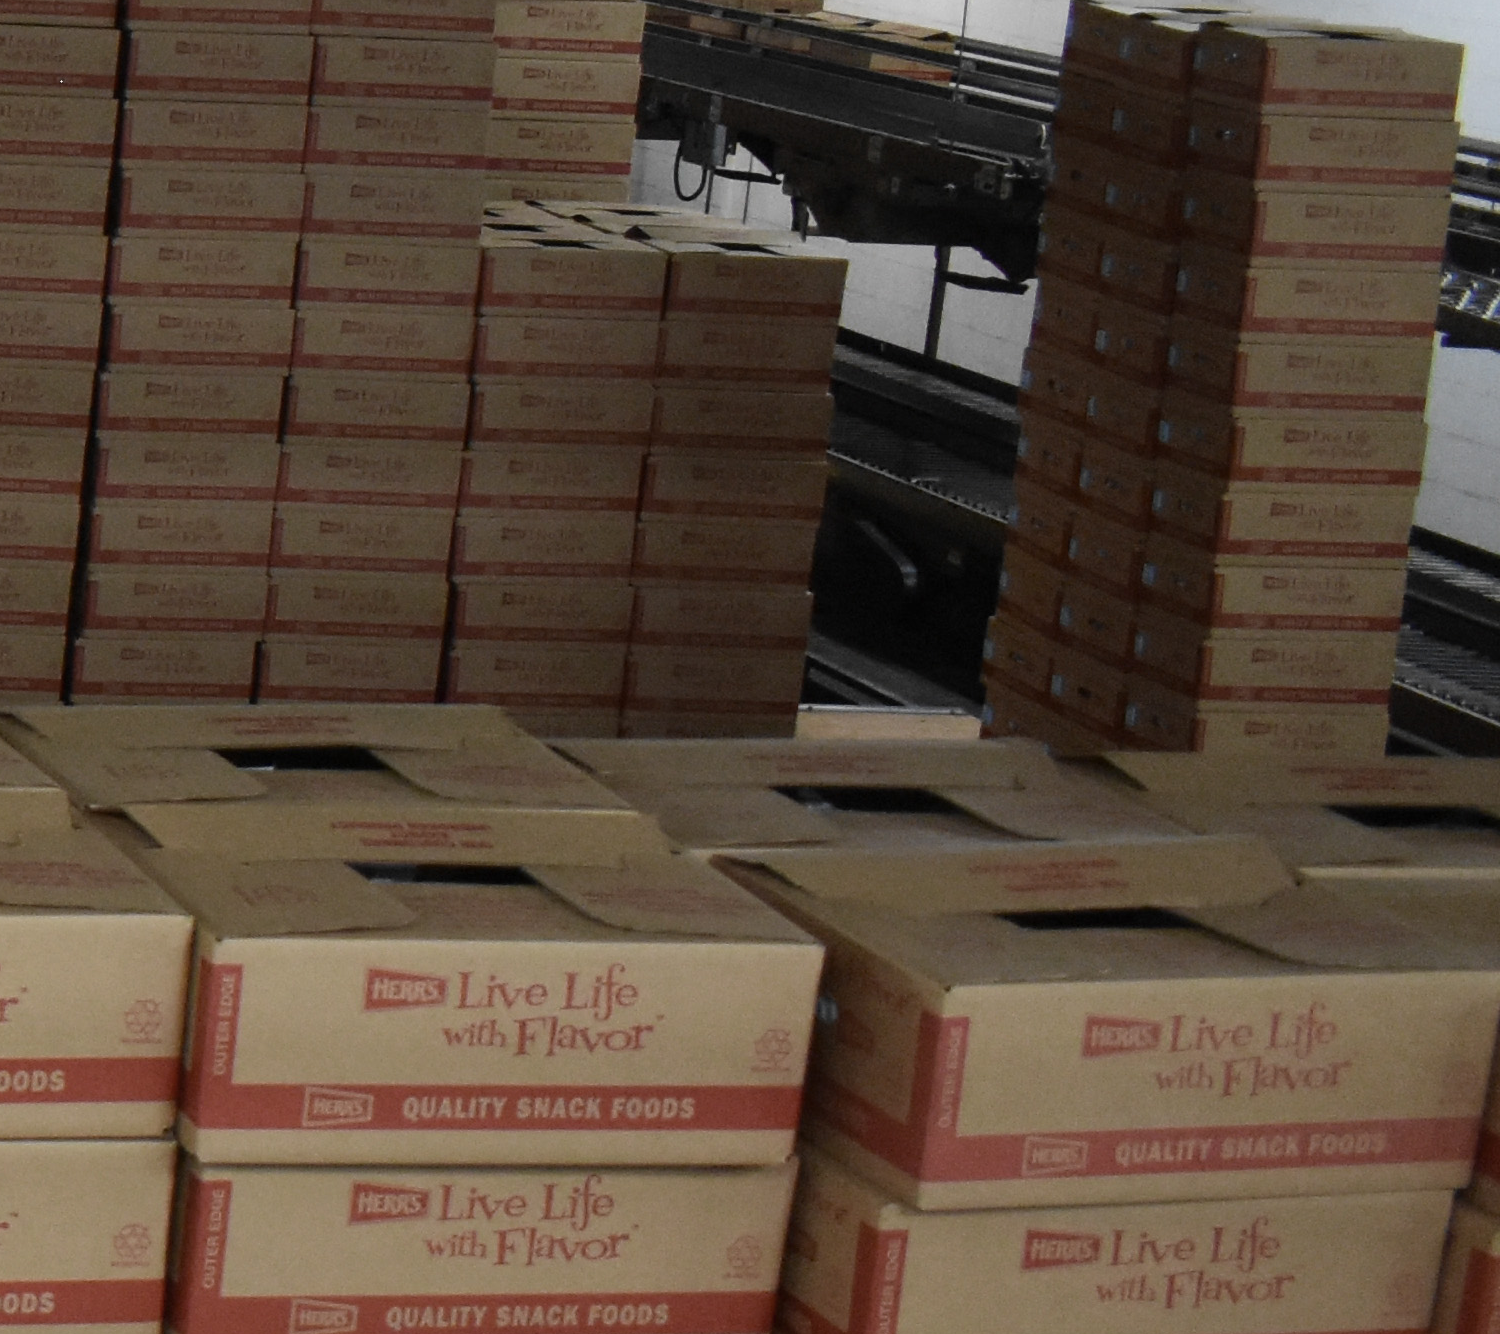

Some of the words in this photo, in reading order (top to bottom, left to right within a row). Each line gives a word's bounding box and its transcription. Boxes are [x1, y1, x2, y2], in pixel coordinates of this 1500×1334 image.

[456, 971, 548, 1011] Live
[563, 963, 638, 1021] Life
[443, 1021, 507, 1048] with
[513, 1016, 653, 1056] Flavor
[402, 1097, 508, 1121] QUALITY
[516, 1097, 601, 1120] SNACK
[611, 1097, 695, 1120] FOODS
[1110, 1229, 1195, 1266] Live
[1209, 1217, 1280, 1272] Life
[1096, 1279, 1156, 1305] with
[1163, 1270, 1295, 1308] Flavor
